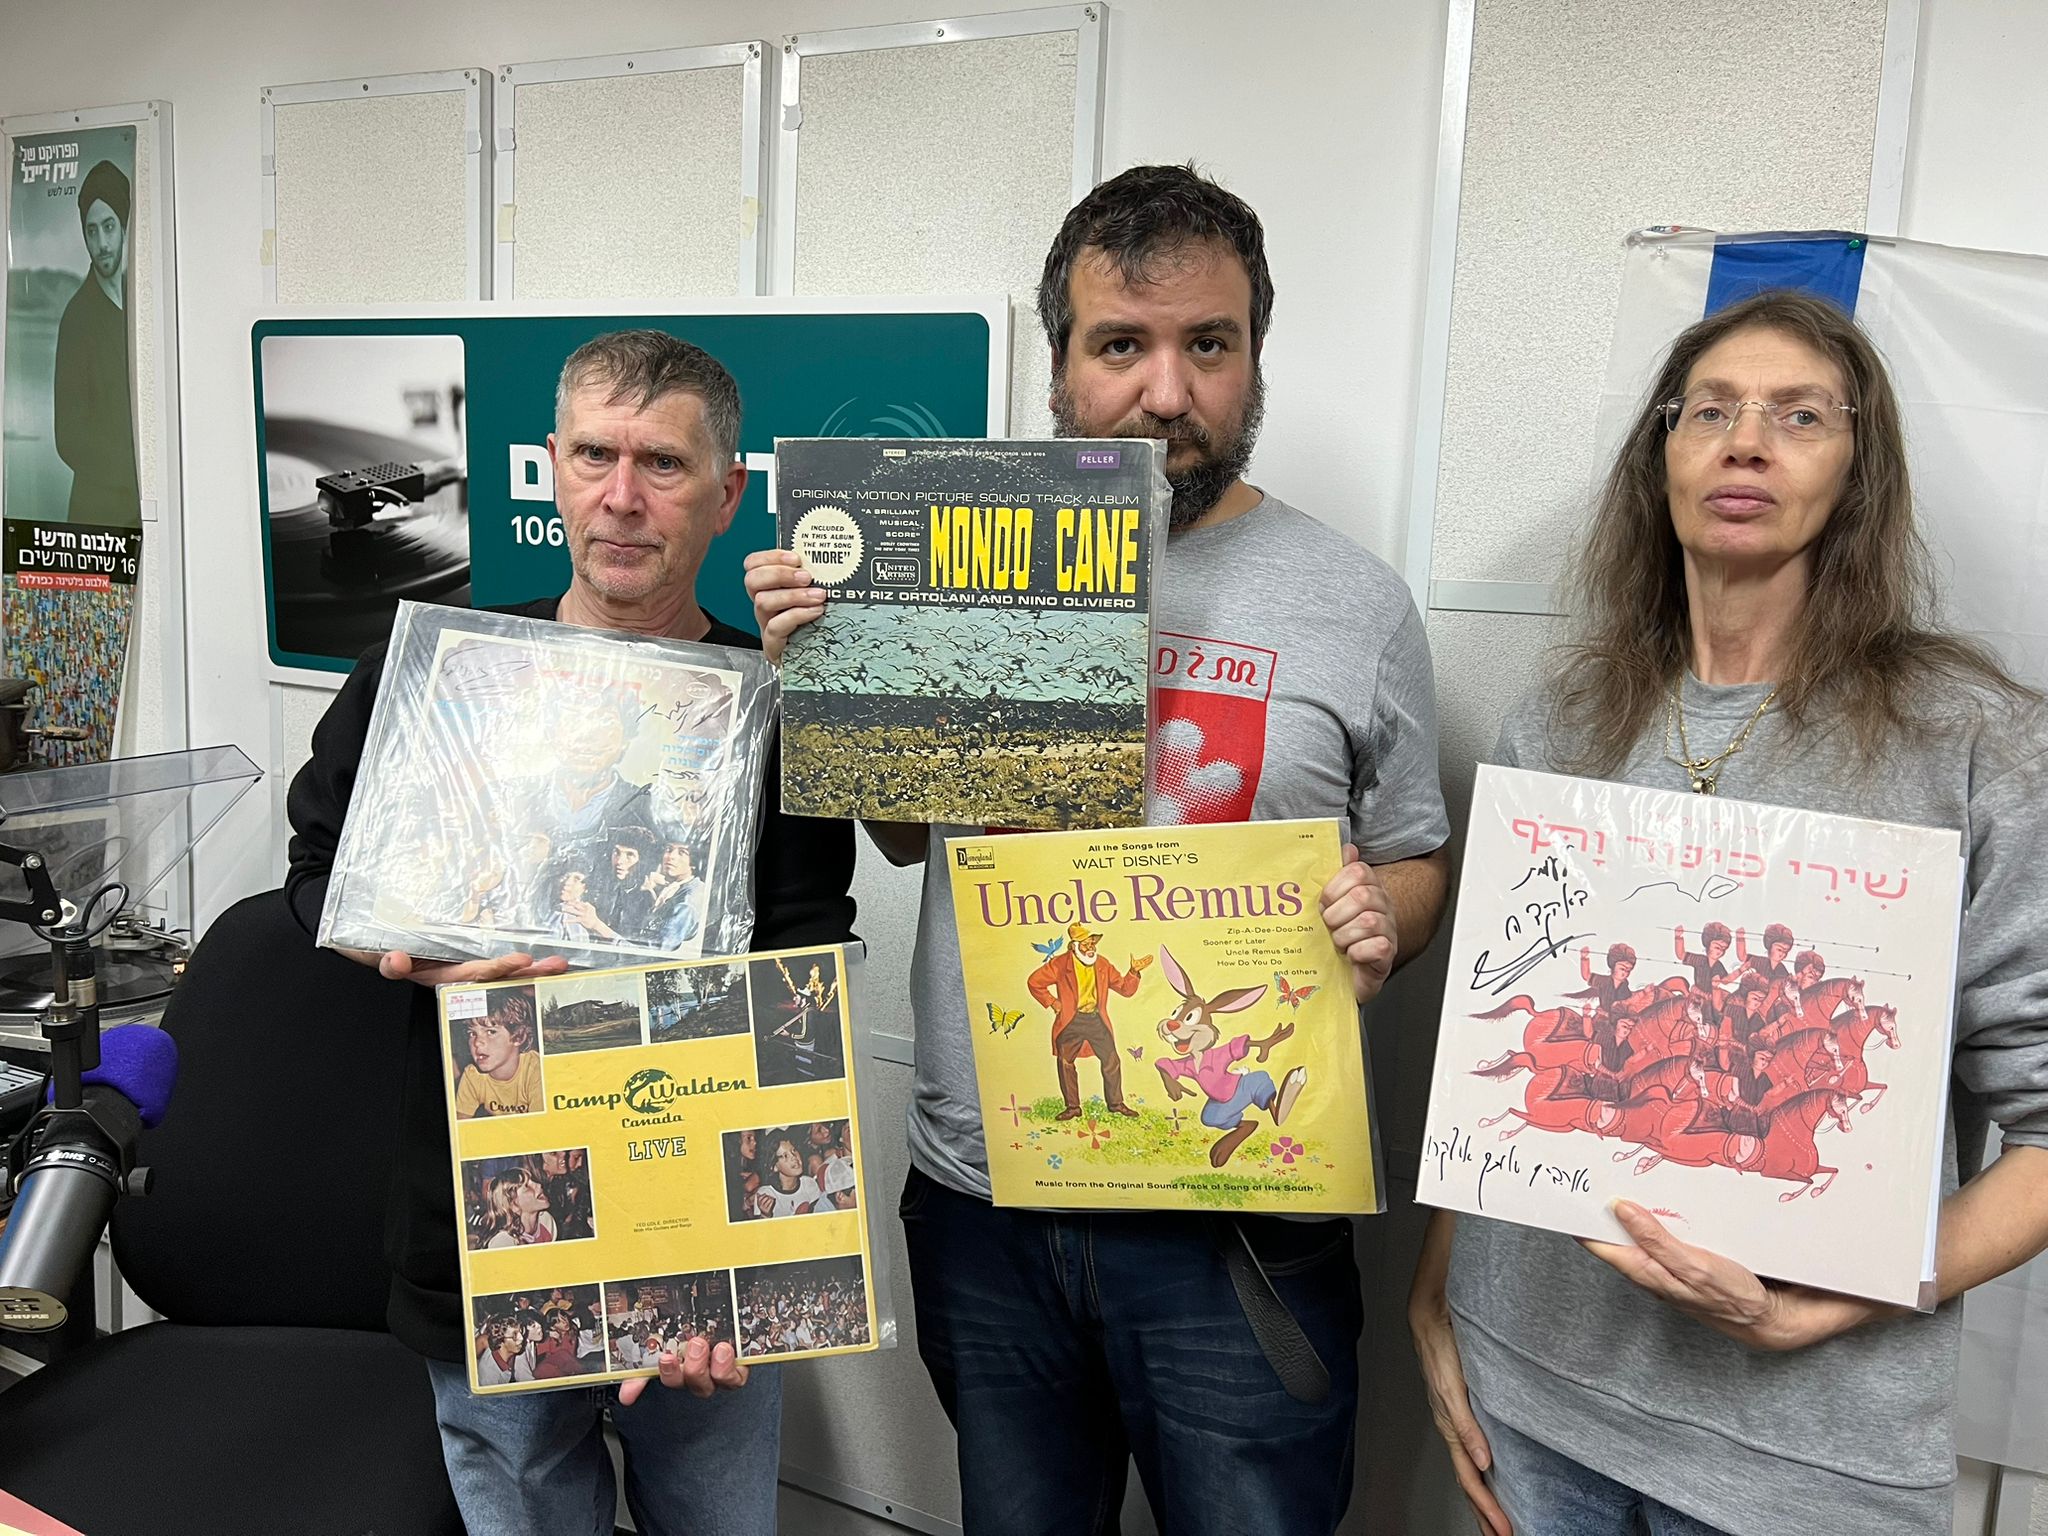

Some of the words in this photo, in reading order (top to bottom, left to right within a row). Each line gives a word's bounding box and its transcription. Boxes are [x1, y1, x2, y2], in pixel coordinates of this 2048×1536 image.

[20, 146, 36, 162] של
[38, 142, 78, 162] הפרויקט
[53, 161, 78, 183] עידן
[1081, 456, 1114, 464] PELLER
[792, 489, 852, 499] ORIGINAL
[856, 491, 910, 501] MOTION
[915, 492, 974, 502] PICTURE
[980, 493, 1030, 503] SOUND
[1036, 494, 1082, 504] TRACK
[1087, 495, 1139, 505] ALBUM
[34, 527, 76, 549] חדש!
[81, 532, 126, 554] אלבום
[19, 549, 74, 568] חדשים
[804, 551, 851, 564] "MORE"
[930, 506, 1034, 590] MONDO
[1056, 508, 1140, 594] CANE
[78, 554, 116, 572] שירים
[121, 558, 136, 575] 16
[20, 574, 54, 585] כפולה
[85, 577, 109, 588] אלבום
[846, 590, 866, 600] BY
[870, 591, 894, 600] RIZ
[900, 592, 977, 603] ORTOLANI
[978, 595, 1013, 605] AND
[1018, 596, 1058, 606] NINO
[1063, 597, 1136, 608] OLIVIERO
[1088, 844, 1100, 852] All
[1122, 843, 1154, 852] Songs
[1072, 857, 1115, 870] WALT
[1123, 852, 1199, 868] DISNEY'S
[974, 878, 1118, 928] Uncle
[1124, 874, 1302, 922] Remus
[1227, 926, 1314, 934] Zip-A-Dee-Doo-Dah
[1202, 938, 1232, 946] Sooner
[1226, 948, 1250, 956] Uncle
[553, 1093, 621, 1110] Camp
[650, 1076, 752, 1100] Walden
[621, 1112, 686, 1129] Canada
[628, 1136, 686, 1162] LIVE
[1036, 1180, 1063, 1188] Music
[1106, 1182, 1144, 1190] Original
[1146, 1182, 1178, 1190] Sound
[1223, 1183, 1249, 1192] Song
[1284, 1184, 1314, 1192] South
